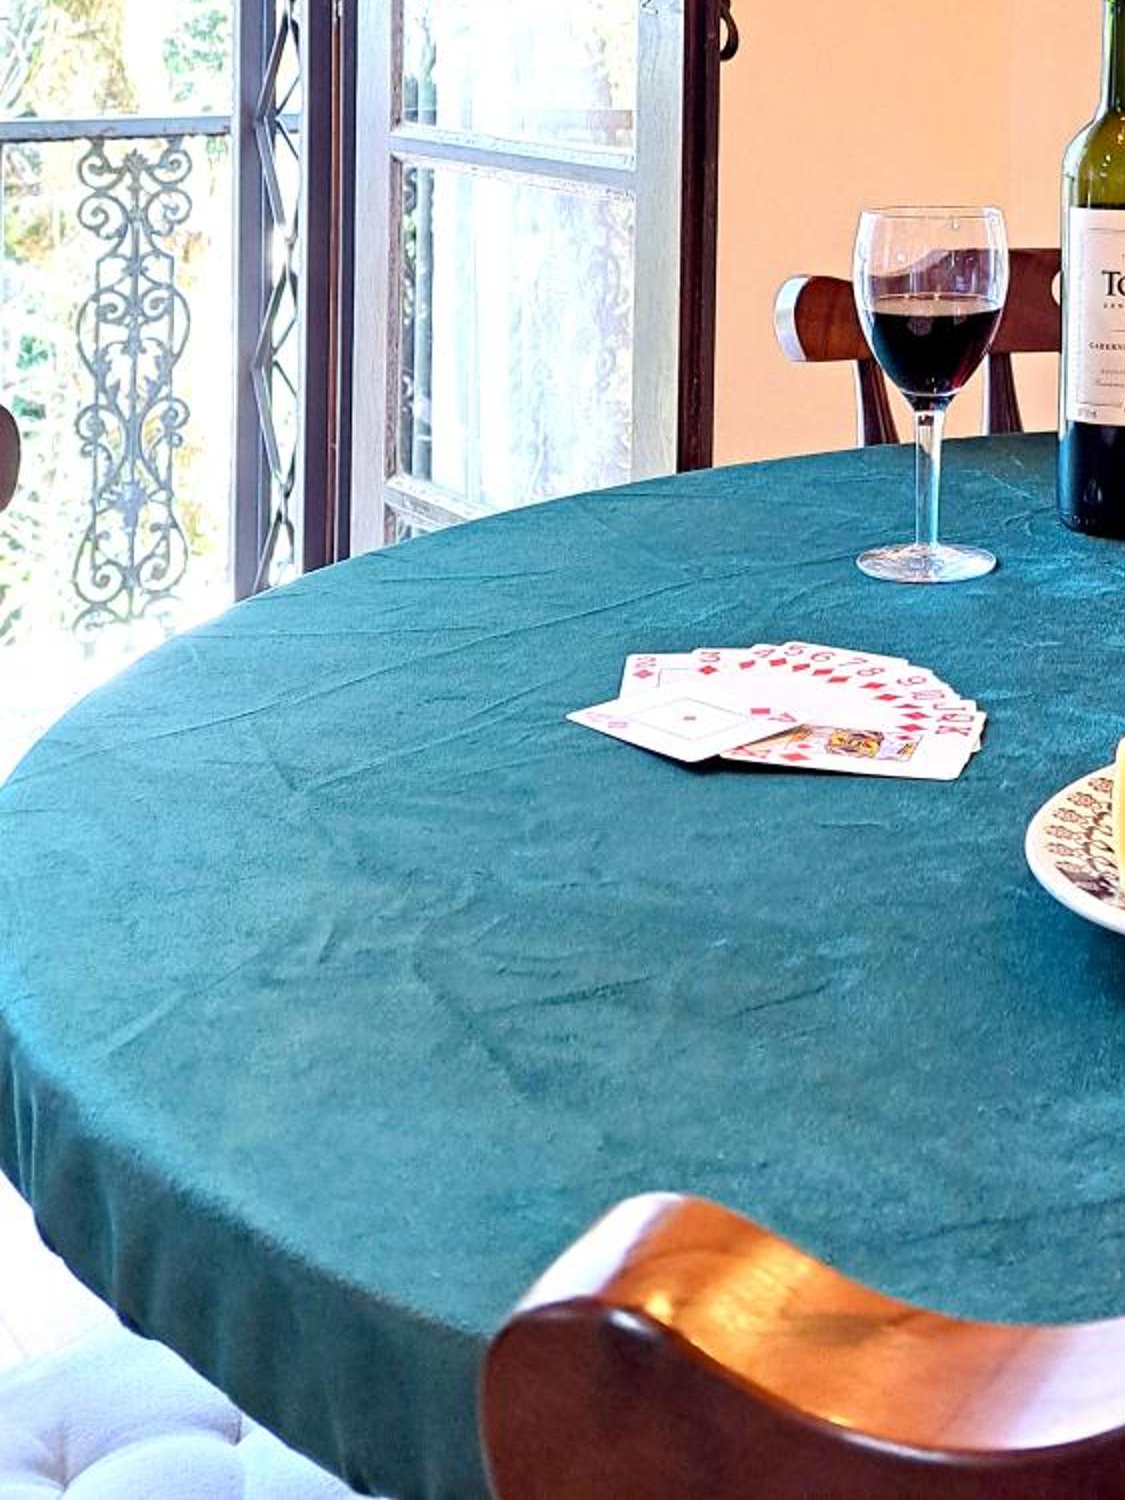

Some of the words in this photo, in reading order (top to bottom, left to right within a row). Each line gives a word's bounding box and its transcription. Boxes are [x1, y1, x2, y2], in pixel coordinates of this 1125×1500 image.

[699, 651, 721, 663] 3
[811, 651, 836, 662] 6
[857, 667, 886, 676] 8
[935, 725, 972, 737] K
